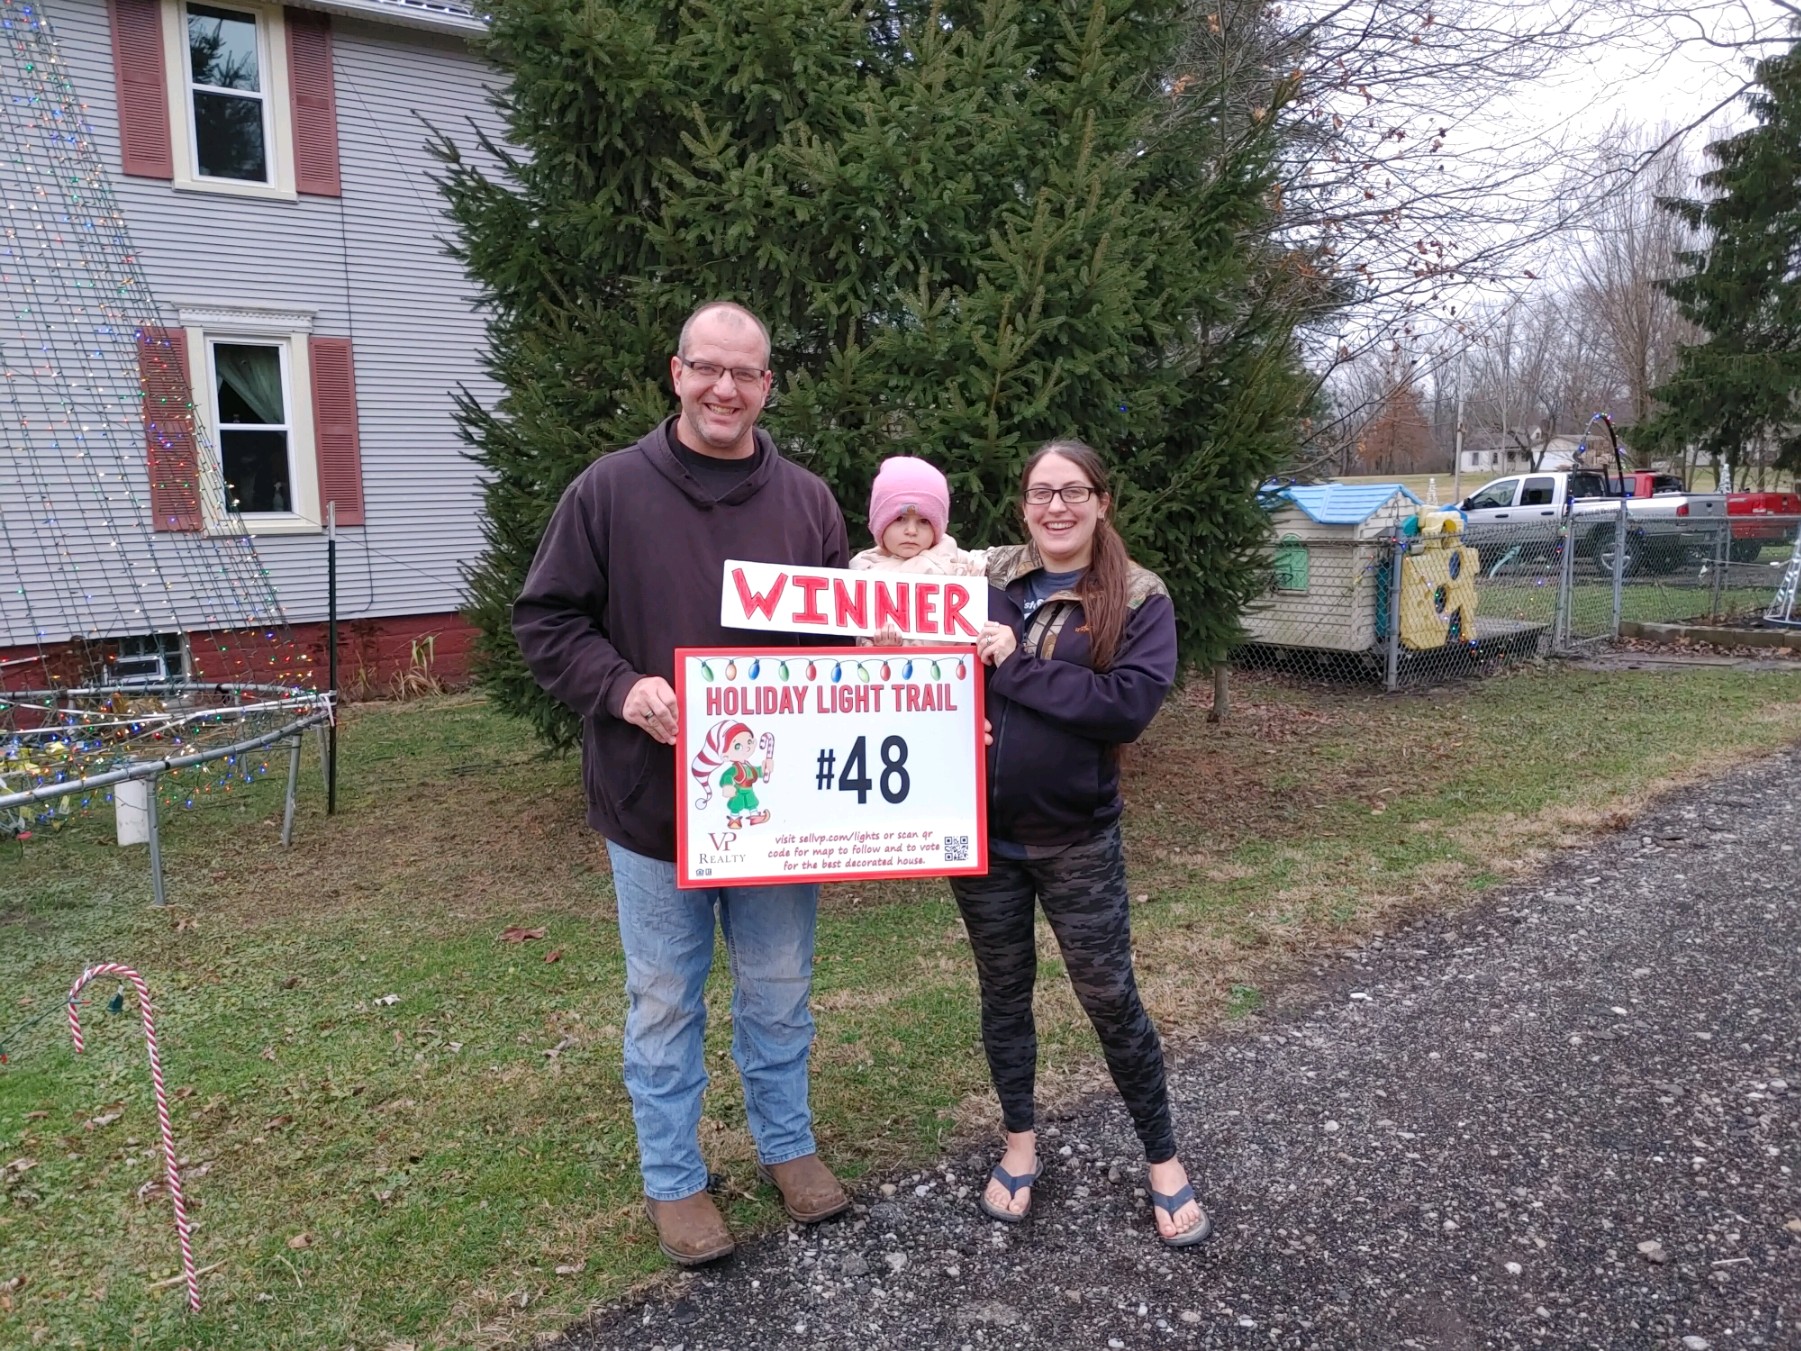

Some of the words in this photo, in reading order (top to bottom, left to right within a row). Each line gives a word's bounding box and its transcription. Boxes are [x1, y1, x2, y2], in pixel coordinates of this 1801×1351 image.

[731, 567, 979, 637] WINNER
[706, 685, 808, 715] HOLIDAY
[816, 684, 885, 714] LIGHT
[891, 683, 958, 712] TRAIL
[815, 735, 911, 804] #48
[707, 831, 737, 851] VP
[775, 834, 796, 844] visit
[799, 830, 880, 845] sellvp.com/lights
[883, 832, 895, 840] or
[897, 831, 919, 840] scan
[922, 831, 933, 841] qr
[768, 847, 790, 858] code
[794, 846, 809, 857] for
[813, 848, 834, 858] map
[838, 846, 848, 855] to
[852, 844, 881, 855] follow
[884, 843, 903, 853] and
[906, 843, 917, 852] to
[920, 843, 940, 851] vote
[783, 860, 798, 870] for
[802, 859, 817, 869] the
[822, 858, 841, 869] best
[845, 856, 893, 868] decorated
[897, 856, 925, 866] house.
